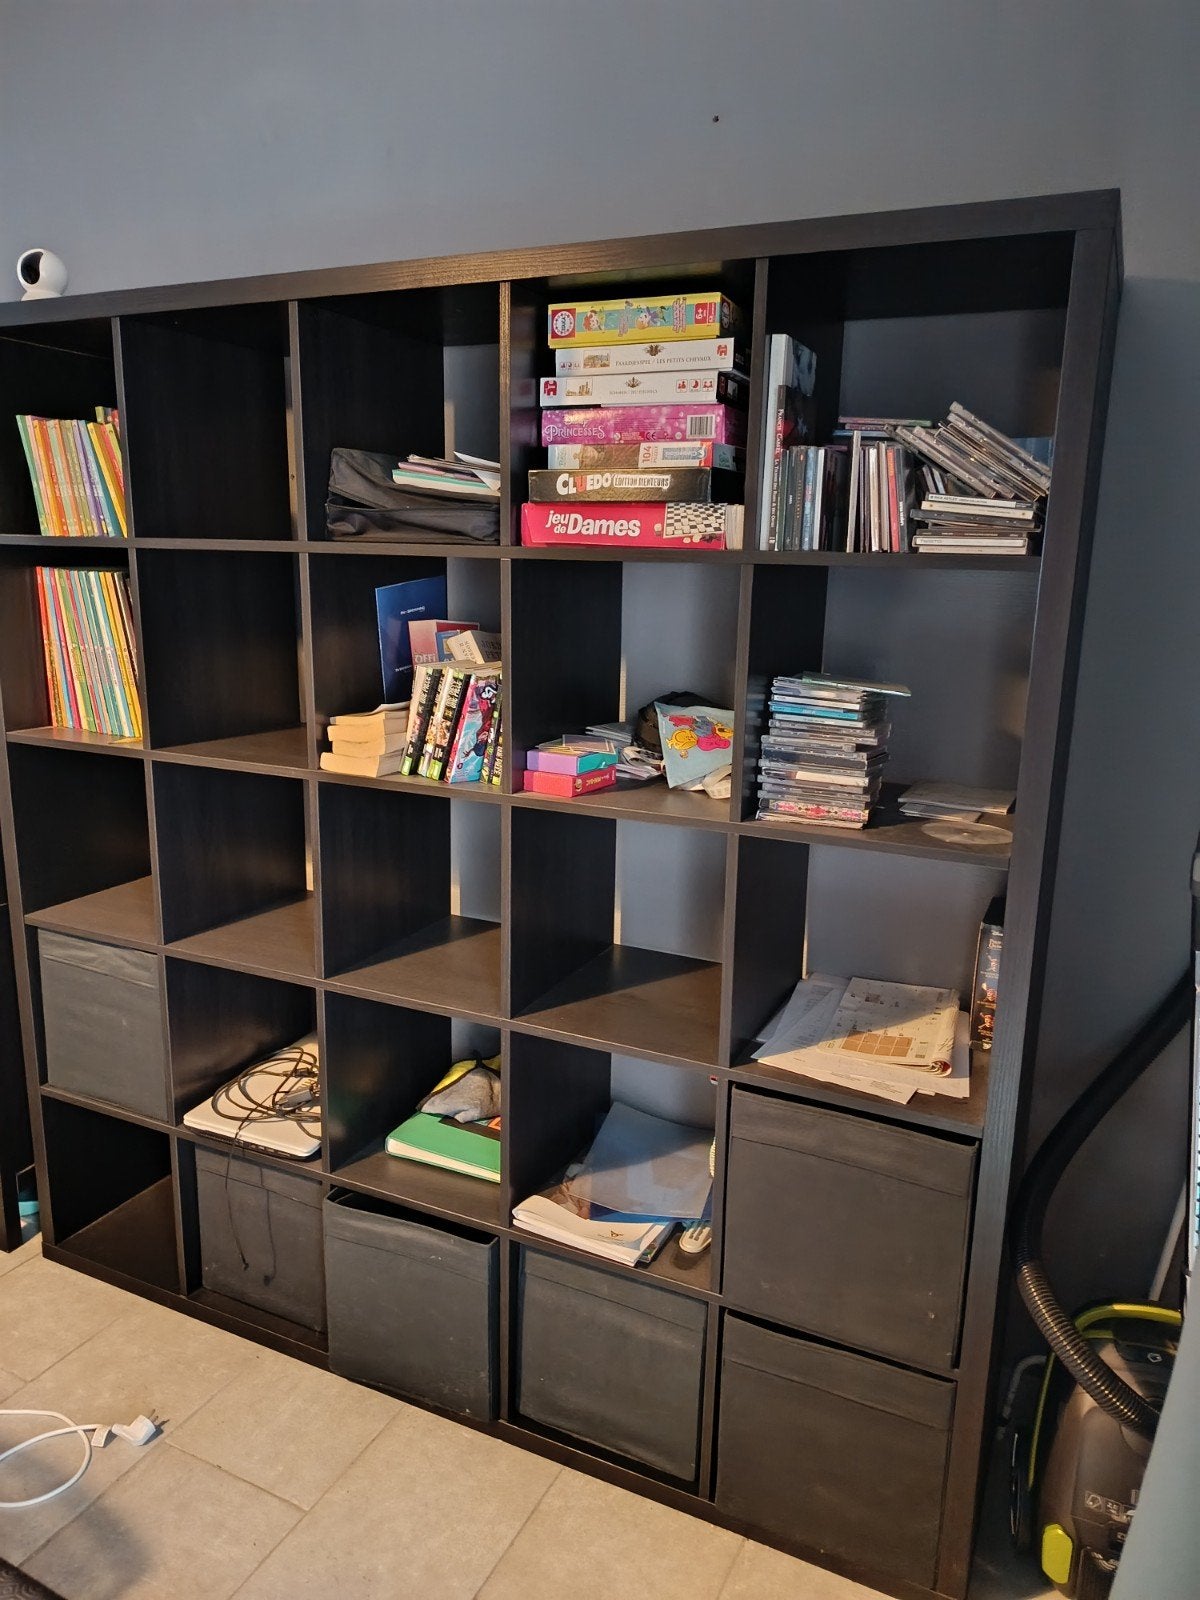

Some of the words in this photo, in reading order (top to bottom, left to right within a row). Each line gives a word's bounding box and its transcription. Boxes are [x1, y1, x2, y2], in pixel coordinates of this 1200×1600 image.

[543, 425, 605, 442] PRINCESSES
[641, 445, 652, 464] 104
[556, 473, 610, 495] CLUEDO
[545, 510, 569, 528] jeu
[567, 513, 641, 537] Dames
[553, 524, 566, 534] de
